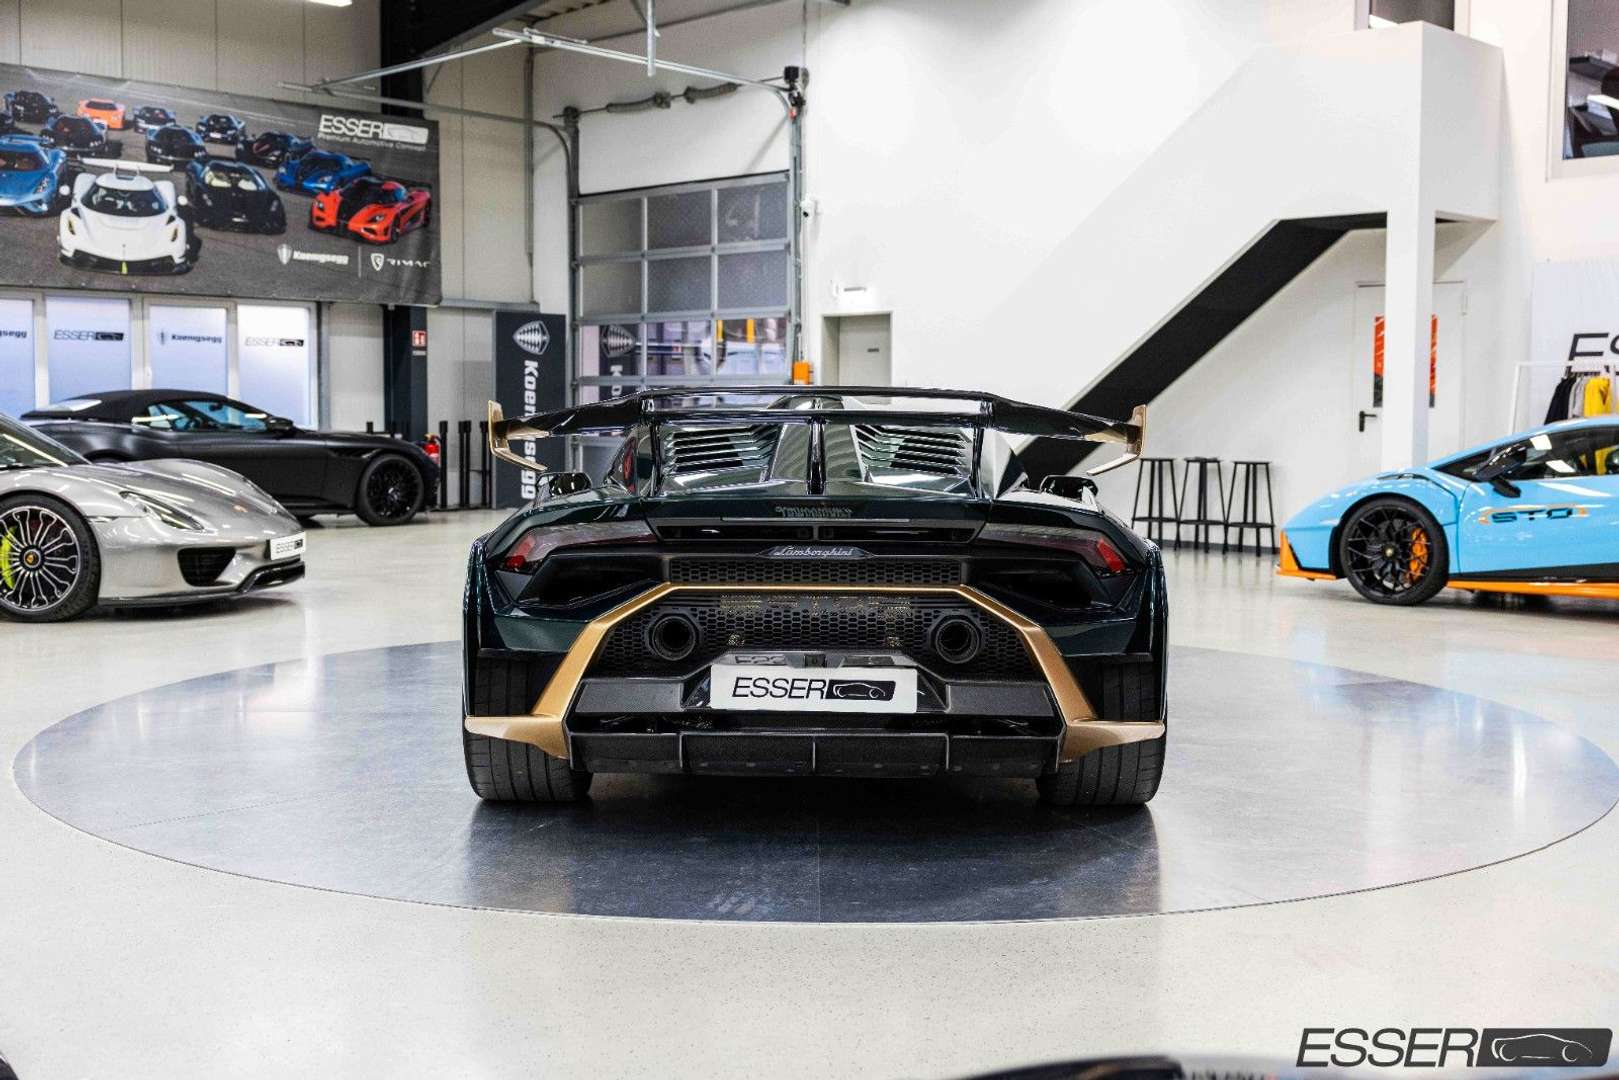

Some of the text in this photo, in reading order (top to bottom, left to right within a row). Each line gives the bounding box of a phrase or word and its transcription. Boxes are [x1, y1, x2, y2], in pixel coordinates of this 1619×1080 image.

[318, 114, 383, 139] ESSER
[352, 137, 394, 148] Automotive
[53, 329, 95, 341] ESSER
[171, 332, 223, 344] Koenigsegg
[1491, 507, 1573, 523] STO
[774, 546, 853, 559] Lamborghini
[732, 677, 826, 700] ESSER
